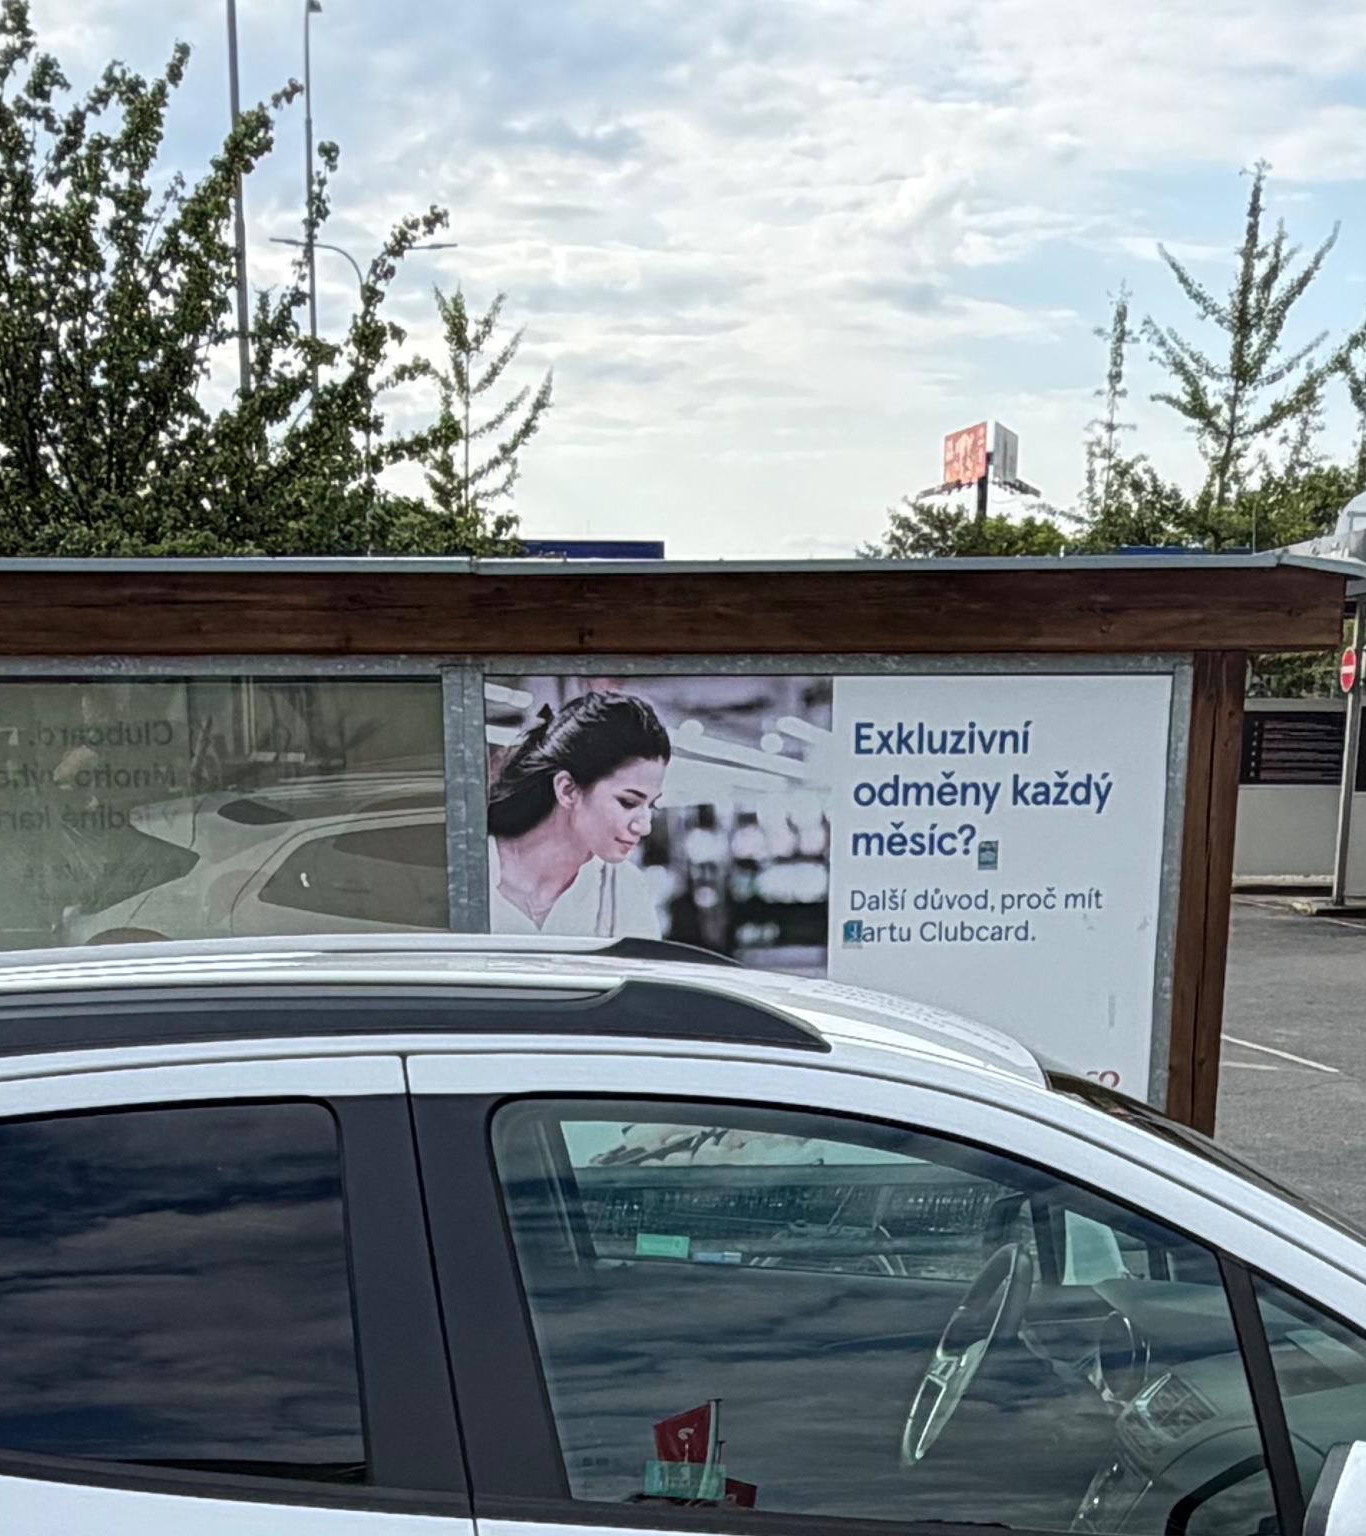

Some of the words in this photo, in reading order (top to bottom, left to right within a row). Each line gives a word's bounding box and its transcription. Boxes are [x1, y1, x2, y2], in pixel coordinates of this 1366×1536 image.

[853, 720, 1033, 755] Exkluzivní
[853, 770, 1002, 815] odměny
[1011, 769, 1114, 815] každý
[851, 820, 978, 856] měsíc?
[849, 888, 908, 911] Další
[913, 887, 996, 912] důvod,
[1000, 887, 1057, 915] proč
[1064, 887, 1104, 910] mít
[845, 920, 912, 942] artu
[919, 920, 1037, 942] Clubcard.
